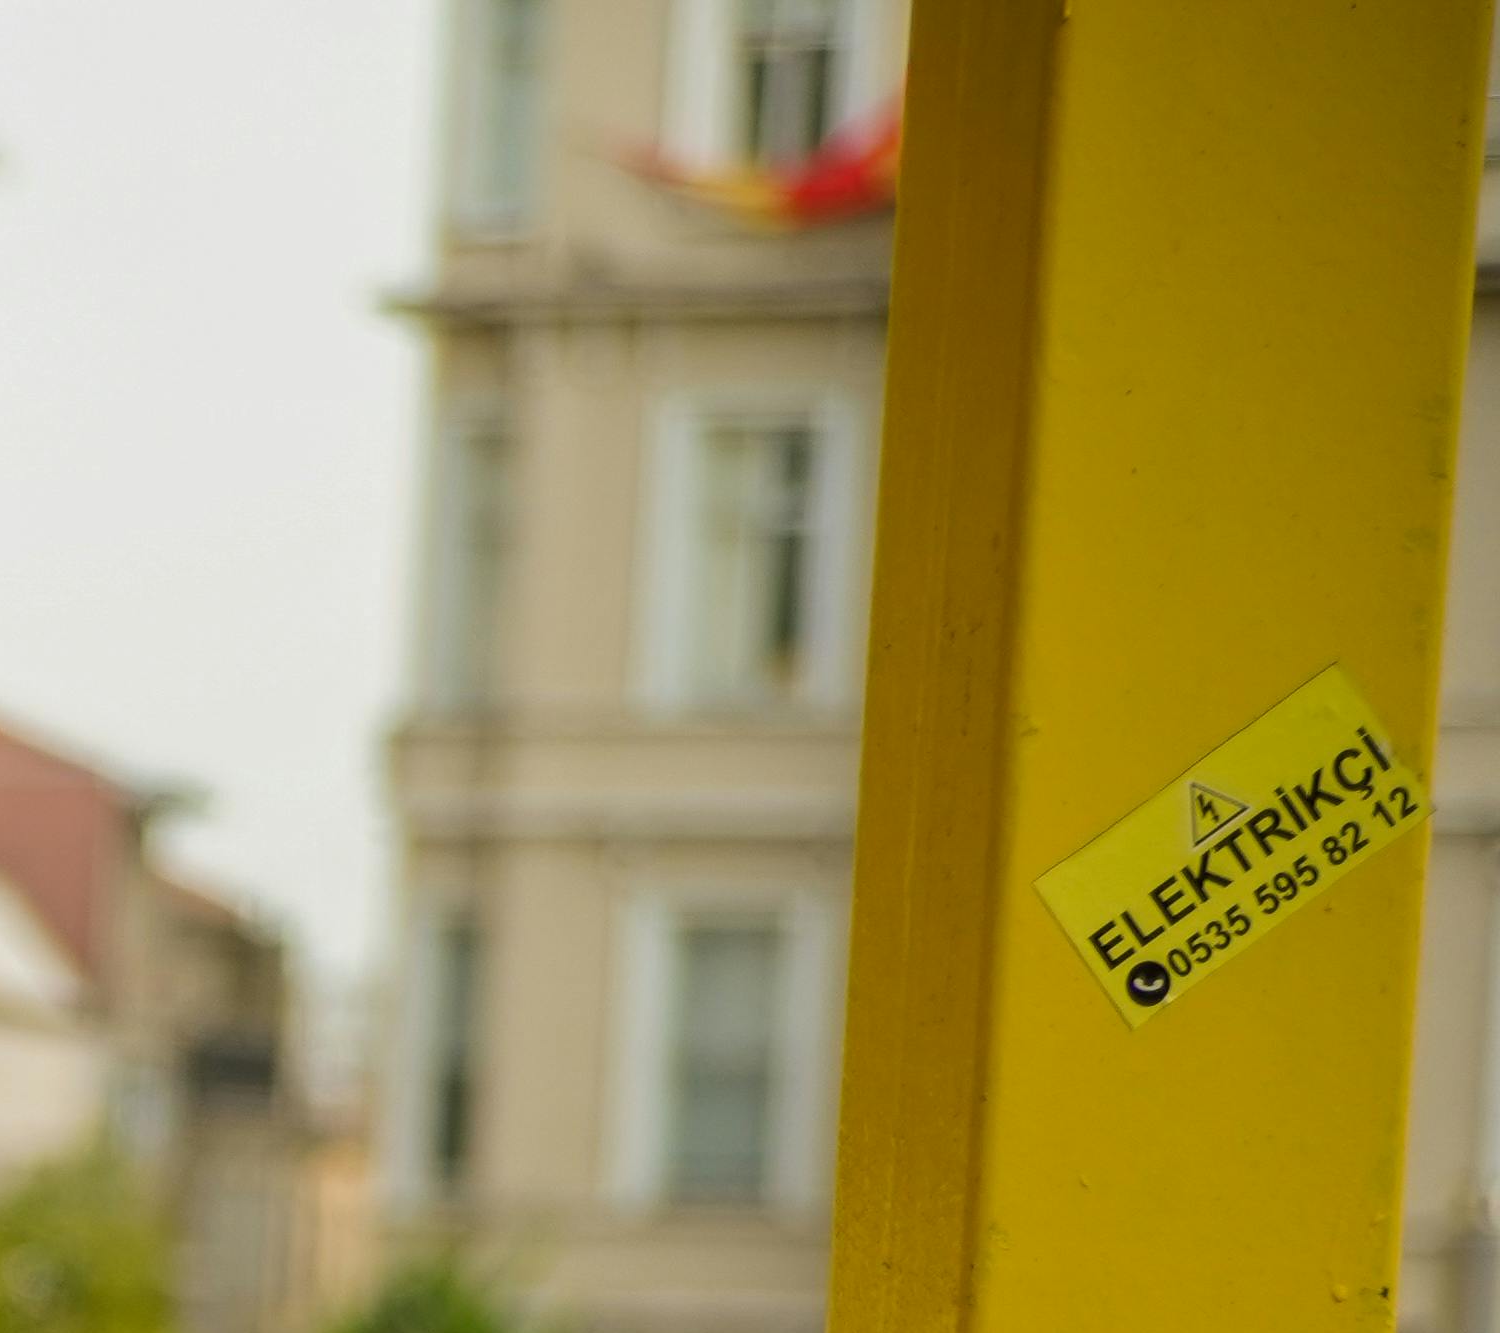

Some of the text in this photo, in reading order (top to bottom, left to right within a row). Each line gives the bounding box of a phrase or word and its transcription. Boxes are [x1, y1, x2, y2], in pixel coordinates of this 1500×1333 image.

[1088, 726, 1392, 971] ELEKTRİKÇİ
[1167, 786, 1419, 978] 0535 595 82 12
